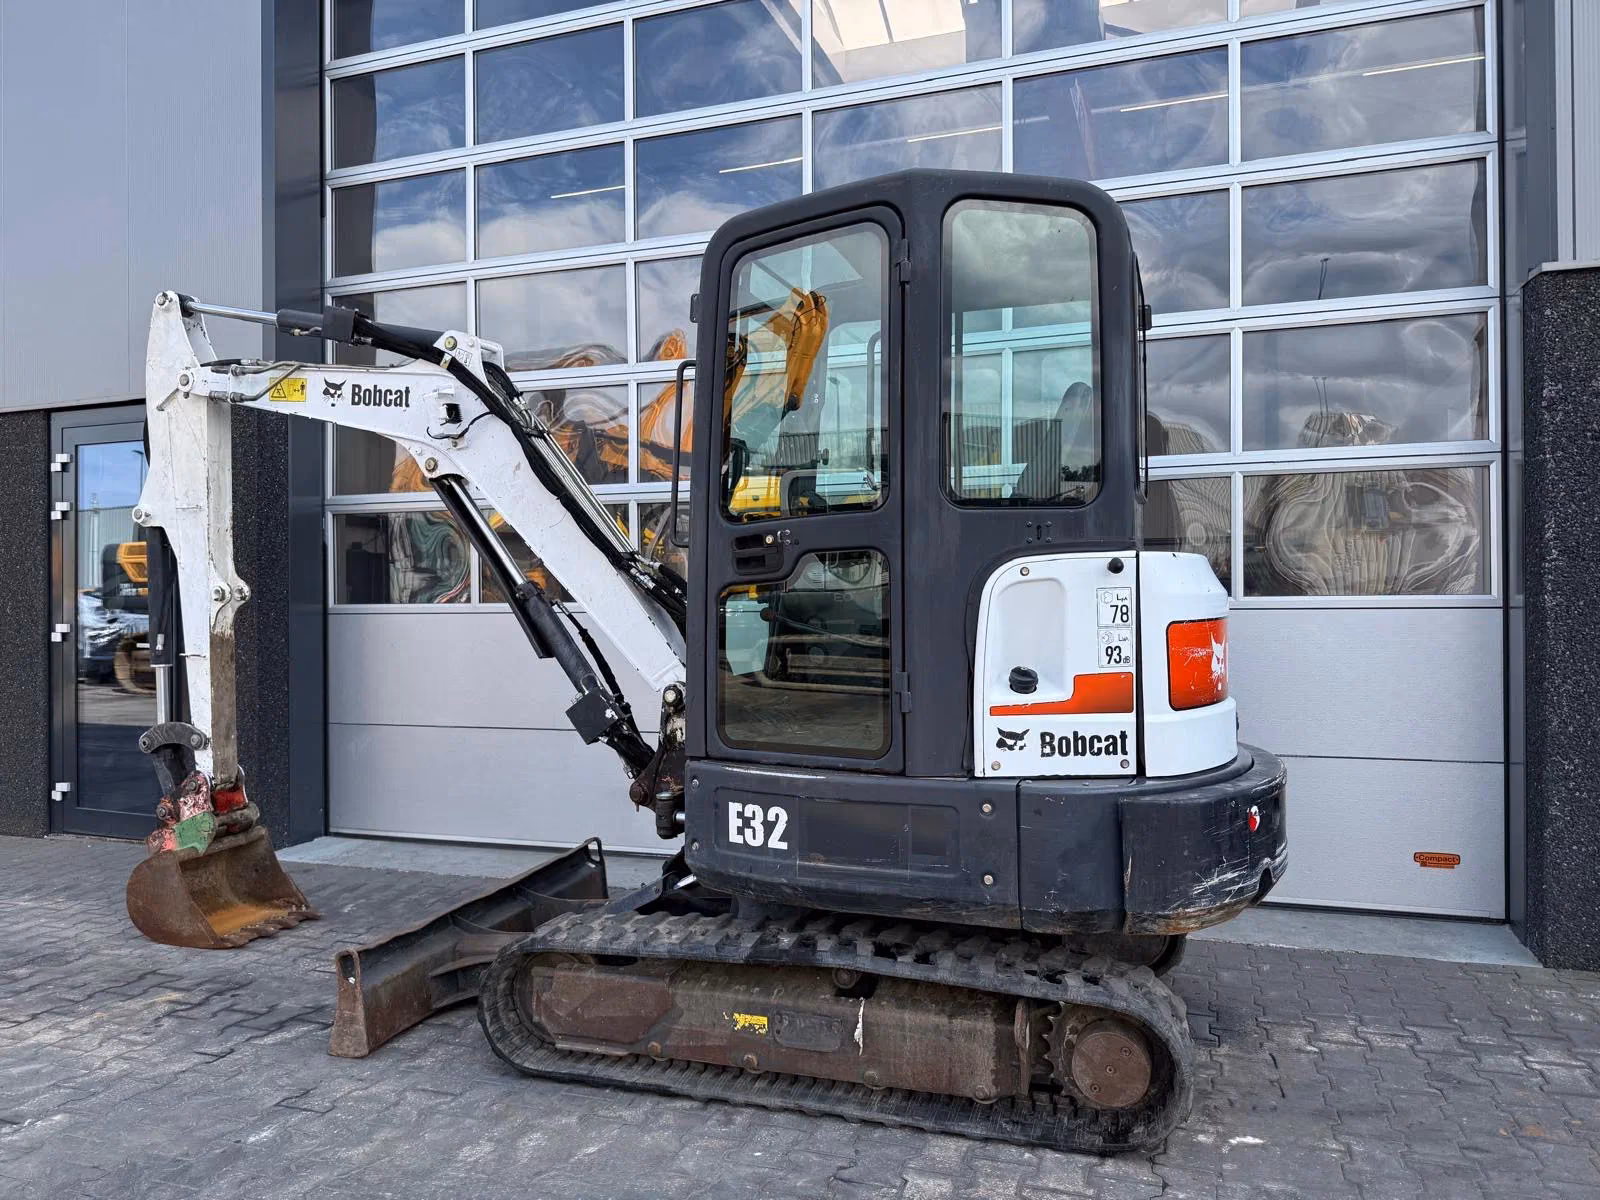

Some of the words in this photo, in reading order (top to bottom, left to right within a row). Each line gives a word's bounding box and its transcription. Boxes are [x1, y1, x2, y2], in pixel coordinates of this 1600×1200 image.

[351, 383, 410, 408] Bobcat
[1109, 604, 1130, 624] 78
[1040, 730, 1128, 758] Bobcat
[728, 801, 788, 850] E32
[1418, 854, 1456, 863] Compact
